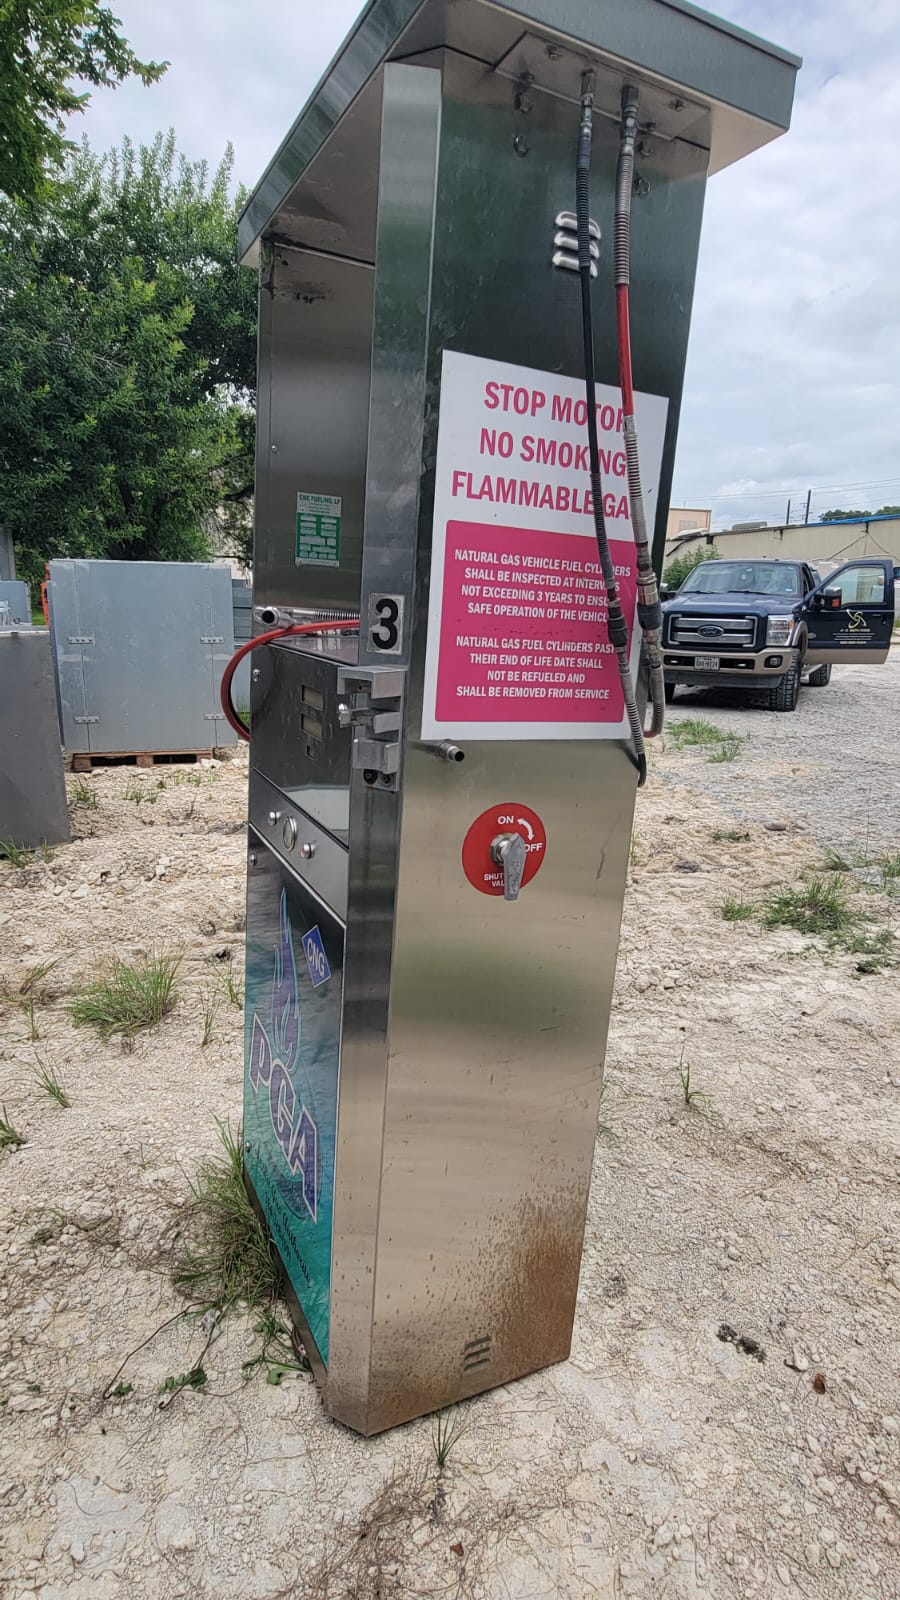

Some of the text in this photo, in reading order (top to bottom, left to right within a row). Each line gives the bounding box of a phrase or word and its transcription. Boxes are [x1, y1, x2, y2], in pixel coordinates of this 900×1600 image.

[484, 382, 545, 417] STOP
[480, 428, 626, 477] NO SMOKNG
[452, 471, 630, 520] FLAMMABLE GA
[455, 549, 498, 564] NATURAL
[501, 554, 519, 566] GAS
[522, 556, 559, 569] VEHICLE
[562, 561, 581, 572] FUEL
[465, 568, 619, 591] SHALL BE INSPECTED AT INTERVS
[462, 585, 480, 596] NOT
[483, 586, 534, 601] EXCEEDING
[537, 591, 542, 601] 3
[545, 592, 572, 603] YEARS
[575, 594, 585, 604] TO
[468, 603, 608, 622] SAFE OPERATION OF THE VEHICL
[371, 598, 398, 650] 3
[456, 635, 499, 649] NATURAL
[501, 638, 519, 649] GAS
[522, 639, 543, 650] FUEL
[546, 640, 592, 653] CYLINDERS
[470, 653, 603, 669] THEIR END OF LIFE DATE SHALL
[488, 671, 585, 683] NOT BE REFUELED AND
[457, 686, 609, 699] SHALL BE REMOVED FROM SERVICE
[498, 816, 514, 824] ON
[524, 843, 543, 852] OFF
[307, 938, 325, 977] CNG
[249, 1012, 317, 1224] PGA
